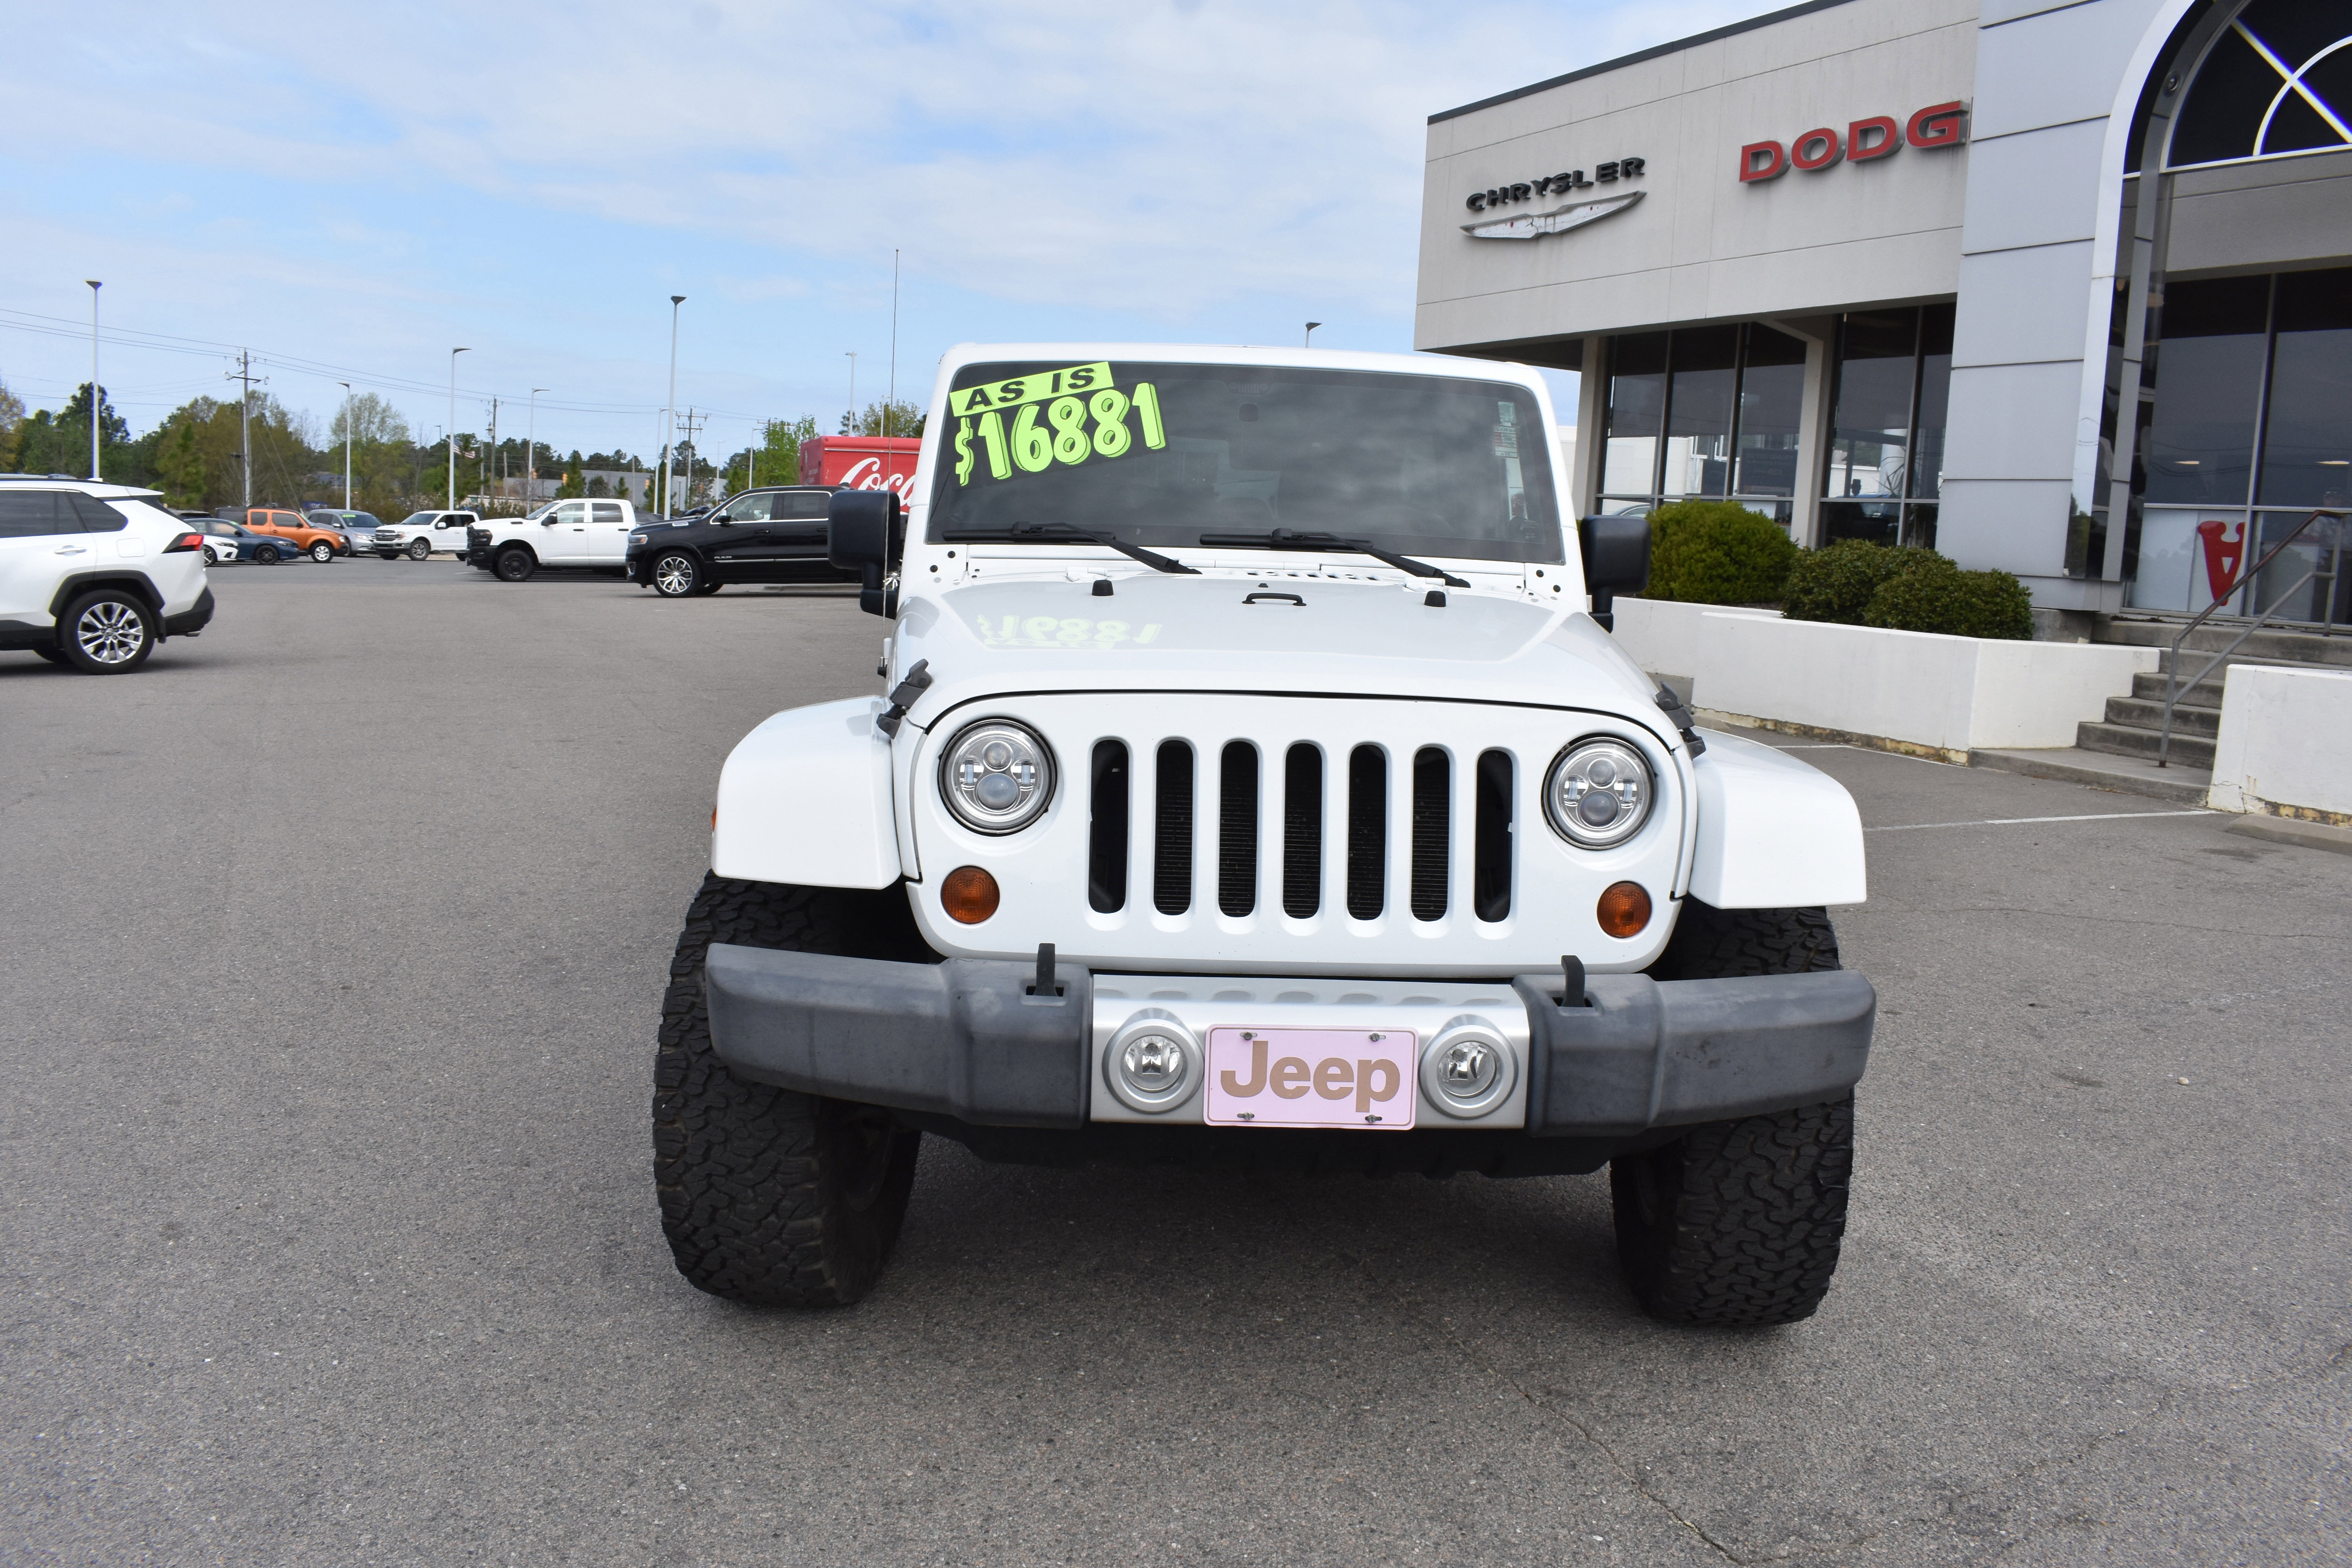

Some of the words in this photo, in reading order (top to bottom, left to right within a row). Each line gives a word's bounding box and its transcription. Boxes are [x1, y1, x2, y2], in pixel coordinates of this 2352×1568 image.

[1739, 100, 1972, 183] DODG
[1466, 156, 1646, 211] CHRYSLER
[964, 380, 1026, 412] AS
[1051, 368, 1096, 394] IS
[955, 382, 1166, 487] $16881
[1220, 1040, 1401, 1113] Jeep
